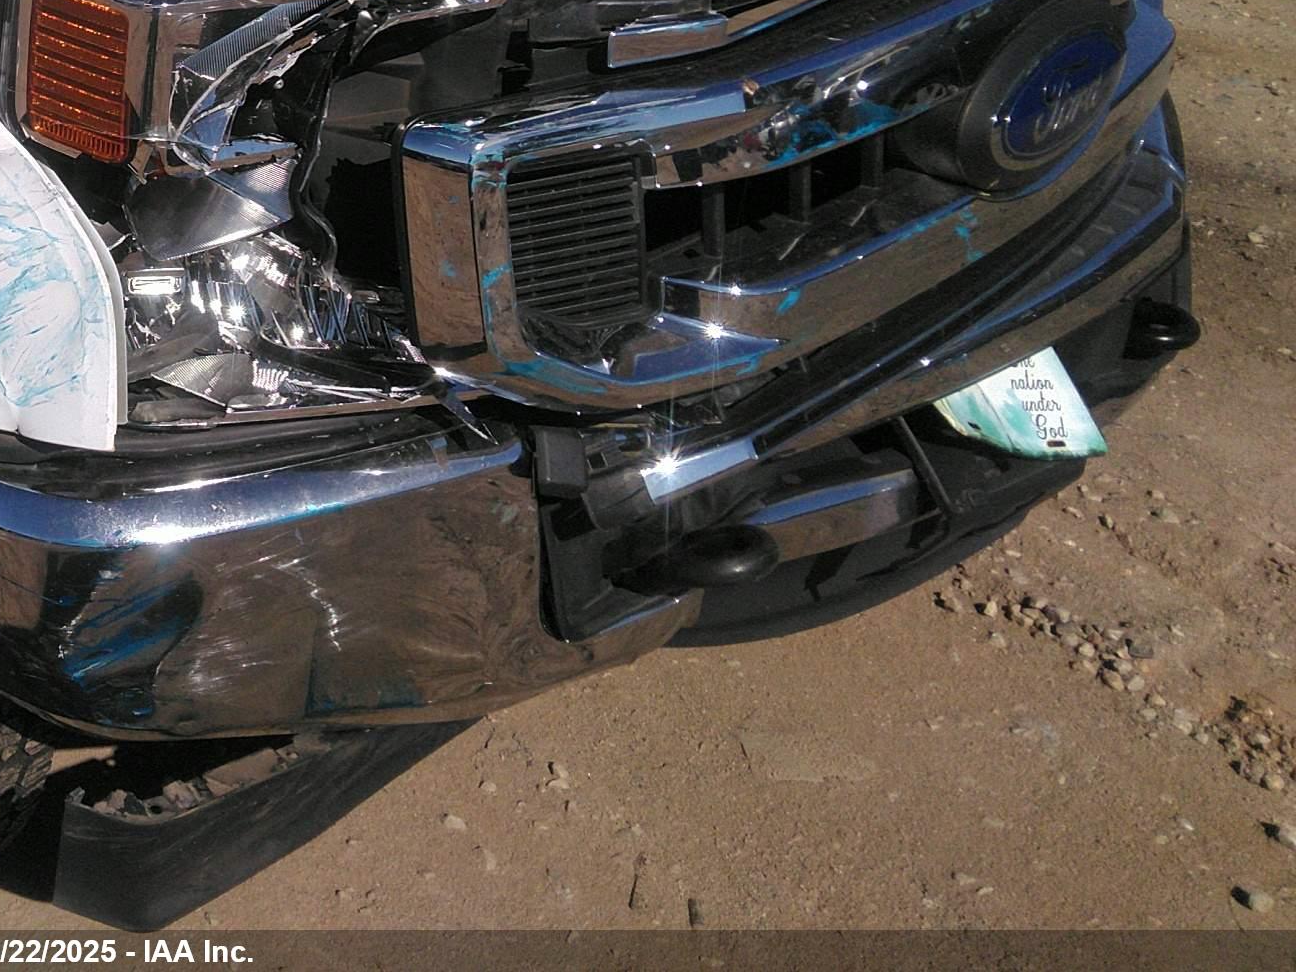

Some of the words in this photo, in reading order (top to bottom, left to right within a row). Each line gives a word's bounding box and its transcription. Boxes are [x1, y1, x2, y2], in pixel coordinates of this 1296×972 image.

[1032, 69, 1102, 145] Ford
[1021, 391, 1062, 411] under
[1035, 414, 1069, 440] God
